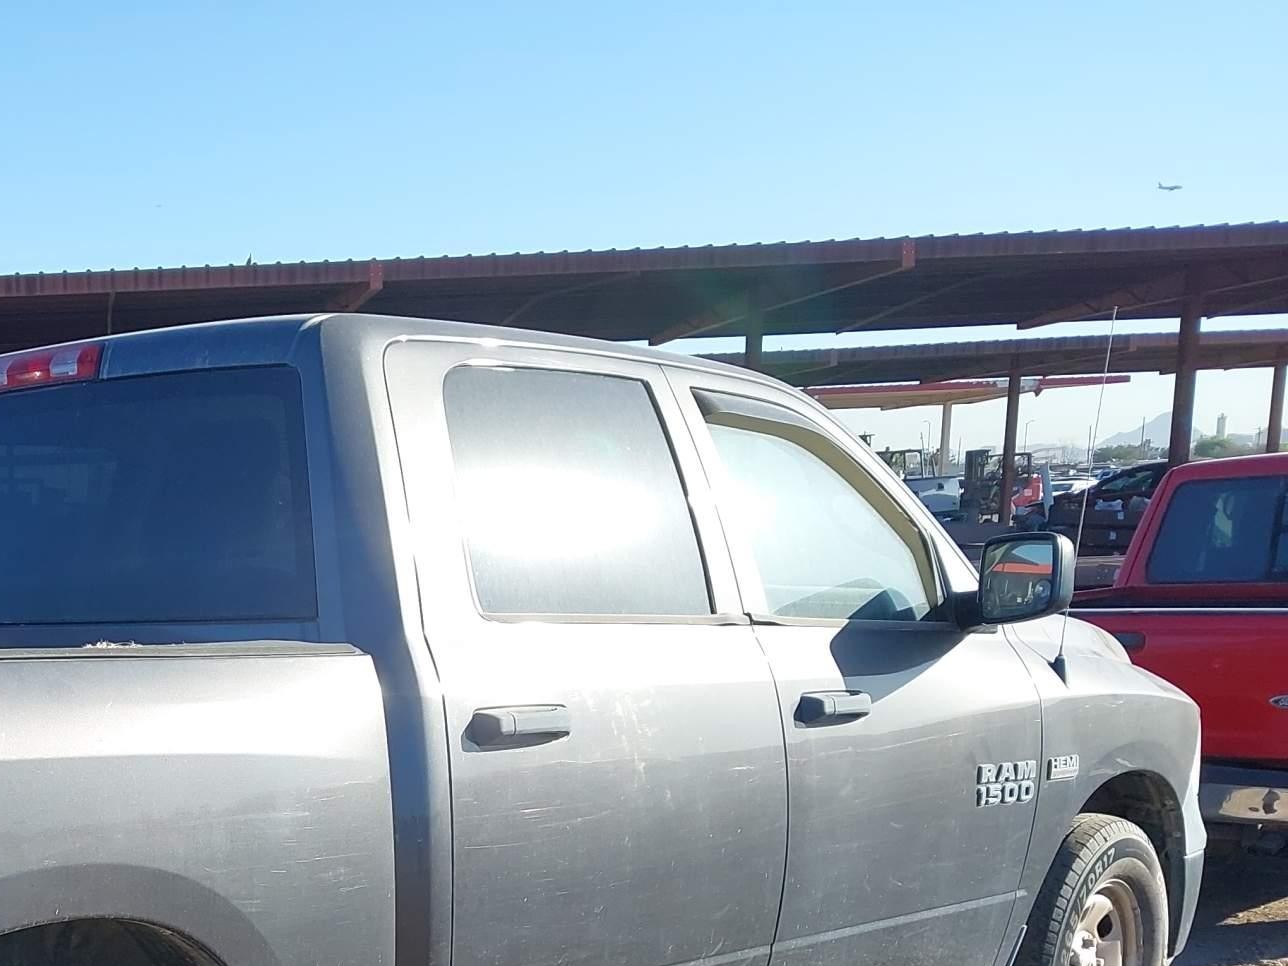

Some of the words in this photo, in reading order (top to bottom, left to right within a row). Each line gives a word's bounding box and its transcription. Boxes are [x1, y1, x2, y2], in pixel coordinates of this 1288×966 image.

[976, 760, 1037, 784] RAM
[1053, 755, 1079, 769] HEMI
[976, 781, 1035, 808] 1500
